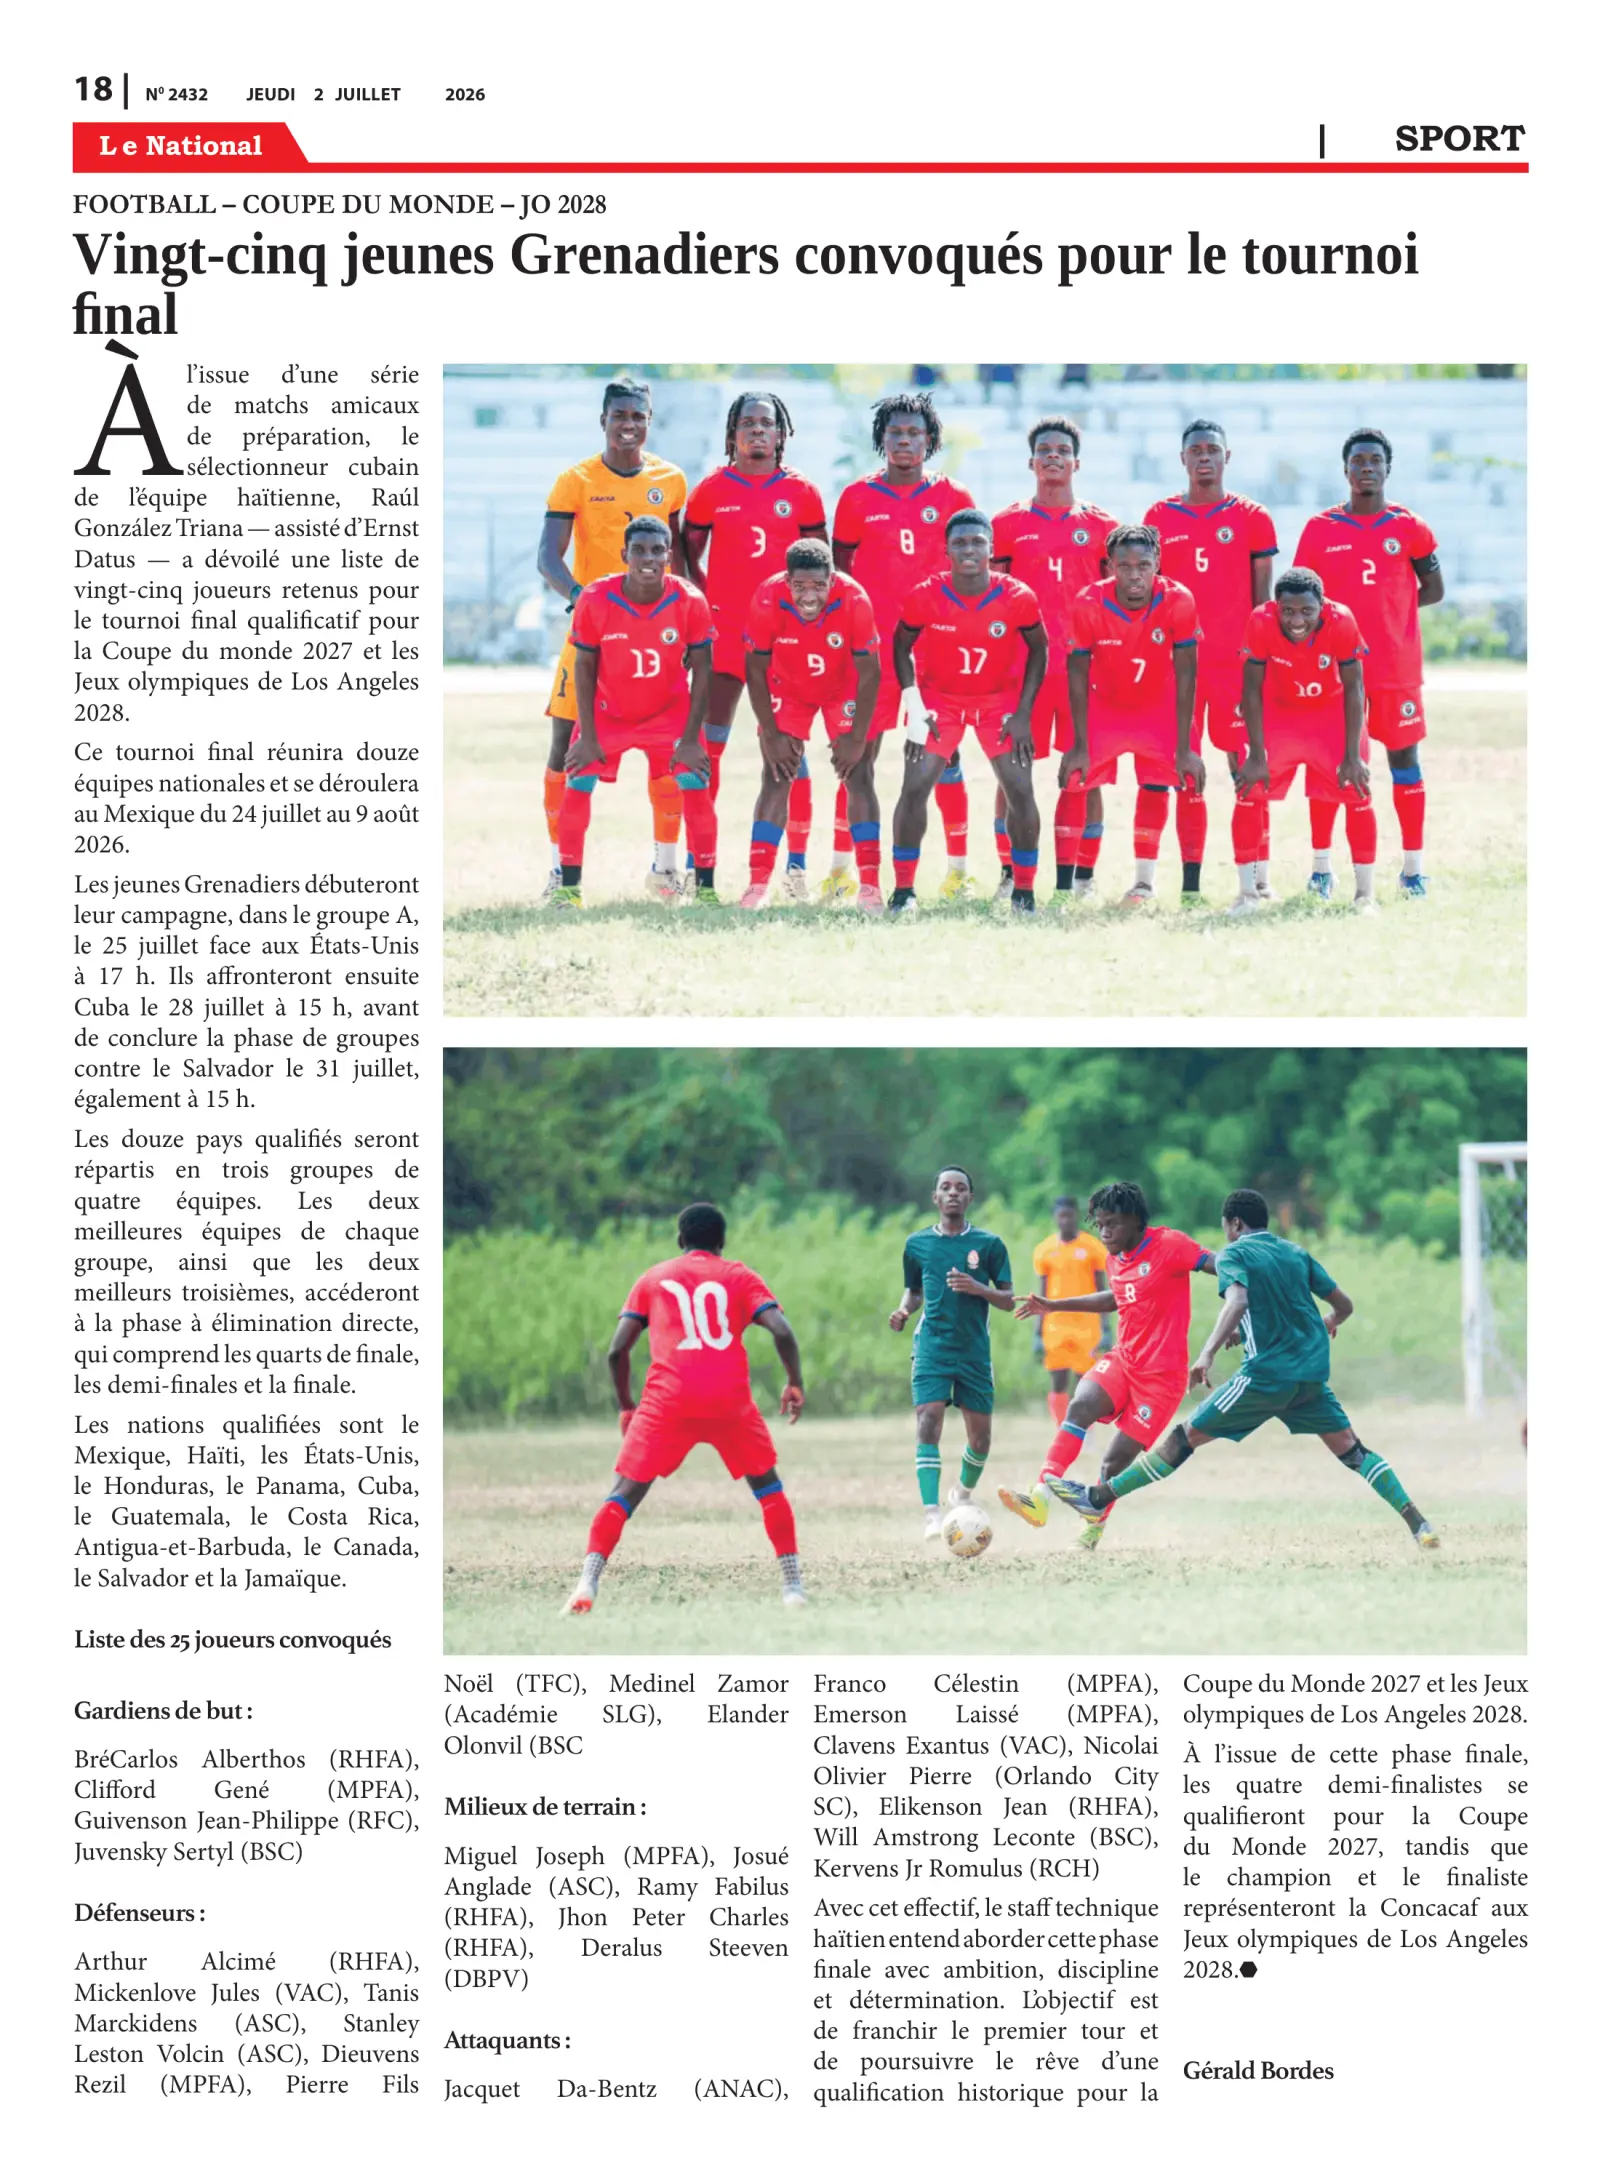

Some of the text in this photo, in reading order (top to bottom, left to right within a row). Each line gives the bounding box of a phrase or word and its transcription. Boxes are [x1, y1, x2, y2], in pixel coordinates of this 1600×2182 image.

[75, 75, 113, 102] 18
[168, 87, 208, 102] 2432
[246, 87, 295, 102] JEUDI
[314, 87, 324, 101] 2
[334, 87, 402, 102] JUILLET
[445, 87, 486, 102] 2026
[146, 134, 263, 156] National
[1395, 124, 1526, 152] SPORT
[72, 193, 217, 214] FOOTBALL
[242, 194, 335, 214] COUPE
[342, 194, 382, 214] DU
[388, 194, 494, 214] MONDE
[518, 194, 551, 221] JO
[557, 194, 607, 214] 2028
[72, 230, 1419, 288] Vingt-cinq jeunes Grenadiers convoqués pour le tournoi
[71, 290, 178, 335] final
[370, 364, 419, 384] série
[73, 338, 185, 476] À
[187, 394, 420, 414] de matchs amicaux
[74, 517, 172, 537] González
[175, 518, 244, 537] Triana
[274, 517, 340, 537] assisté
[751, 526, 766, 558] 3
[900, 528, 915, 555] 8
[1048, 557, 1063, 582] 4
[1362, 559, 1376, 585] 2
[630, 648, 661, 678] 13
[807, 653, 826, 676] 9
[958, 647, 988, 675] 17
[1131, 658, 1146, 683] 7
[74, 802, 420, 829] au Mexique du 24 juillet au 9 août
[74, 835, 130, 854] 2026.
[74, 931, 419, 961] le 25 juillet face aux États-Unis
[74, 1189, 420, 1216] quatre équipes. Les deux
[74, 1281, 420, 1304] meilleurs troisièmes, accéderont
[1124, 1282, 1137, 1303] 8
[660, 1279, 734, 1352] 10
[74, 1441, 419, 1471] Mexique, Haïti, les États-Unis,
[74, 1536, 419, 1563] Antigua-et-Barbuda, le Canada,
[74, 1628, 392, 1655] Liste des 25 joueurs convoqués
[444, 1672, 790, 1697] Noël (TFC), Medinel Zamor
[813, 1672, 1159, 1697] Franco Célestin (MPFA),
[74, 1699, 171, 1720] Gardiens
[174, 1699, 202, 1720] de
[74, 1748, 419, 1773] BréCarlos Alberthos (RHFA),
[74, 1778, 419, 1803] Clifford Gené (MPFA),
[1183, 1773, 1528, 1800] les quatre demi-finalistes se
[444, 1795, 528, 1816] Milieux
[532, 1795, 559, 1816] de
[813, 1826, 1159, 1853] Will Amstrong Leconte (BSC),
[444, 1845, 789, 1872] Miguel Joseph (MPFA), Josué
[1183, 1866, 1529, 1893] le champion et le finaliste
[1183, 1896, 1529, 1923] représenteront la Concacaf aux
[74, 1950, 419, 1975] Arthur Alcimé (RHFA),
[813, 1958, 1159, 1985] finale avec ambition, discipline
[74, 1981, 419, 2006] Mickenlove Jules (VAC), Tanis
[1183, 2059, 1335, 2080] Gérald Bordes
[444, 2078, 789, 2104] Jacquet Da-Bentz (ANAC),
